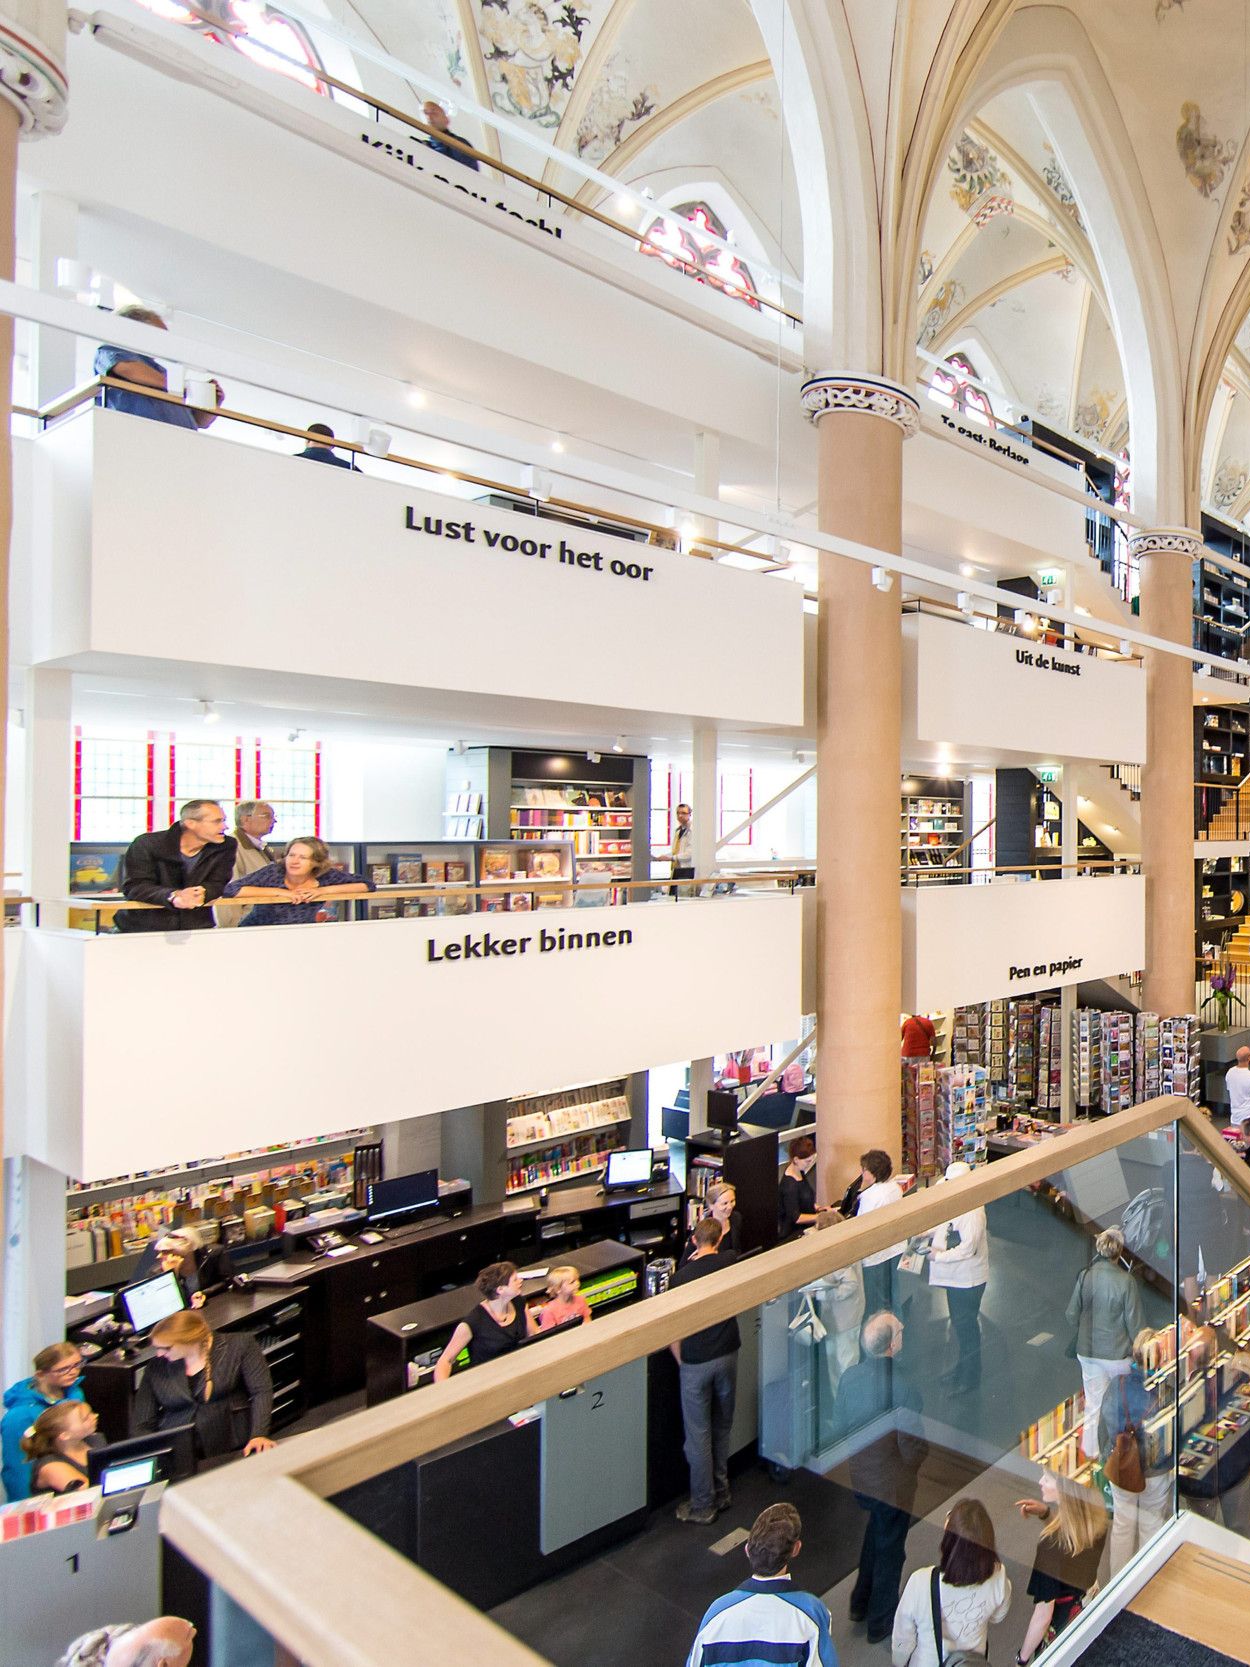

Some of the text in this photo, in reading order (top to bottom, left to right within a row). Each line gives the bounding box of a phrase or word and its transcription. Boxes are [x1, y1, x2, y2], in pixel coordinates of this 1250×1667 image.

[405, 505, 653, 581] Lust voor het oor
[1016, 649, 1081, 676] Uit de kunst
[427, 927, 633, 963] Lekker binnen
[1009, 955, 1084, 981] Pen en papier
[591, 1390, 606, 1411] 2
[65, 1551, 80, 1575] 1
